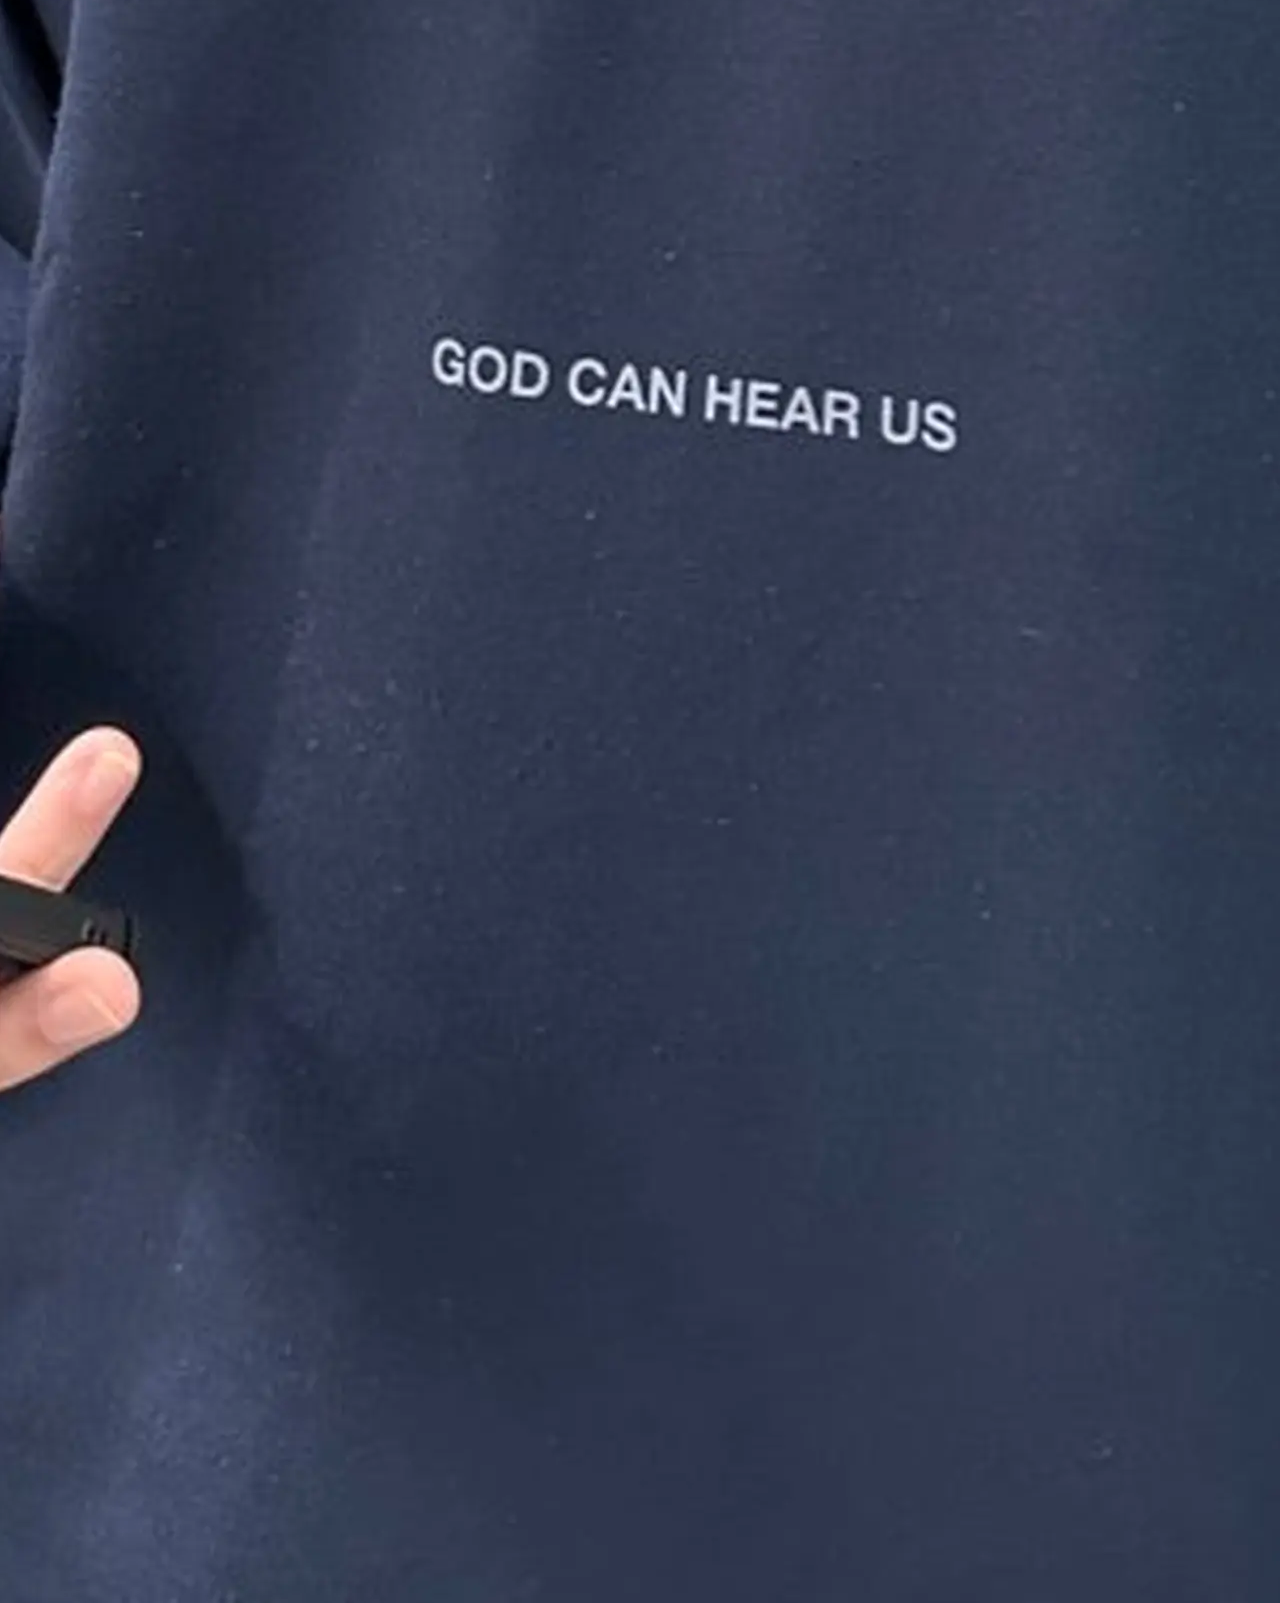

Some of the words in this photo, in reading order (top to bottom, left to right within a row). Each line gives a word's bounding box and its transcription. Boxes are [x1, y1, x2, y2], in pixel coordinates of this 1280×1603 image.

[431, 336, 551, 399] GOD
[566, 357, 688, 418] CAN
[703, 373, 861, 440] HEAR
[880, 394, 958, 453] US
